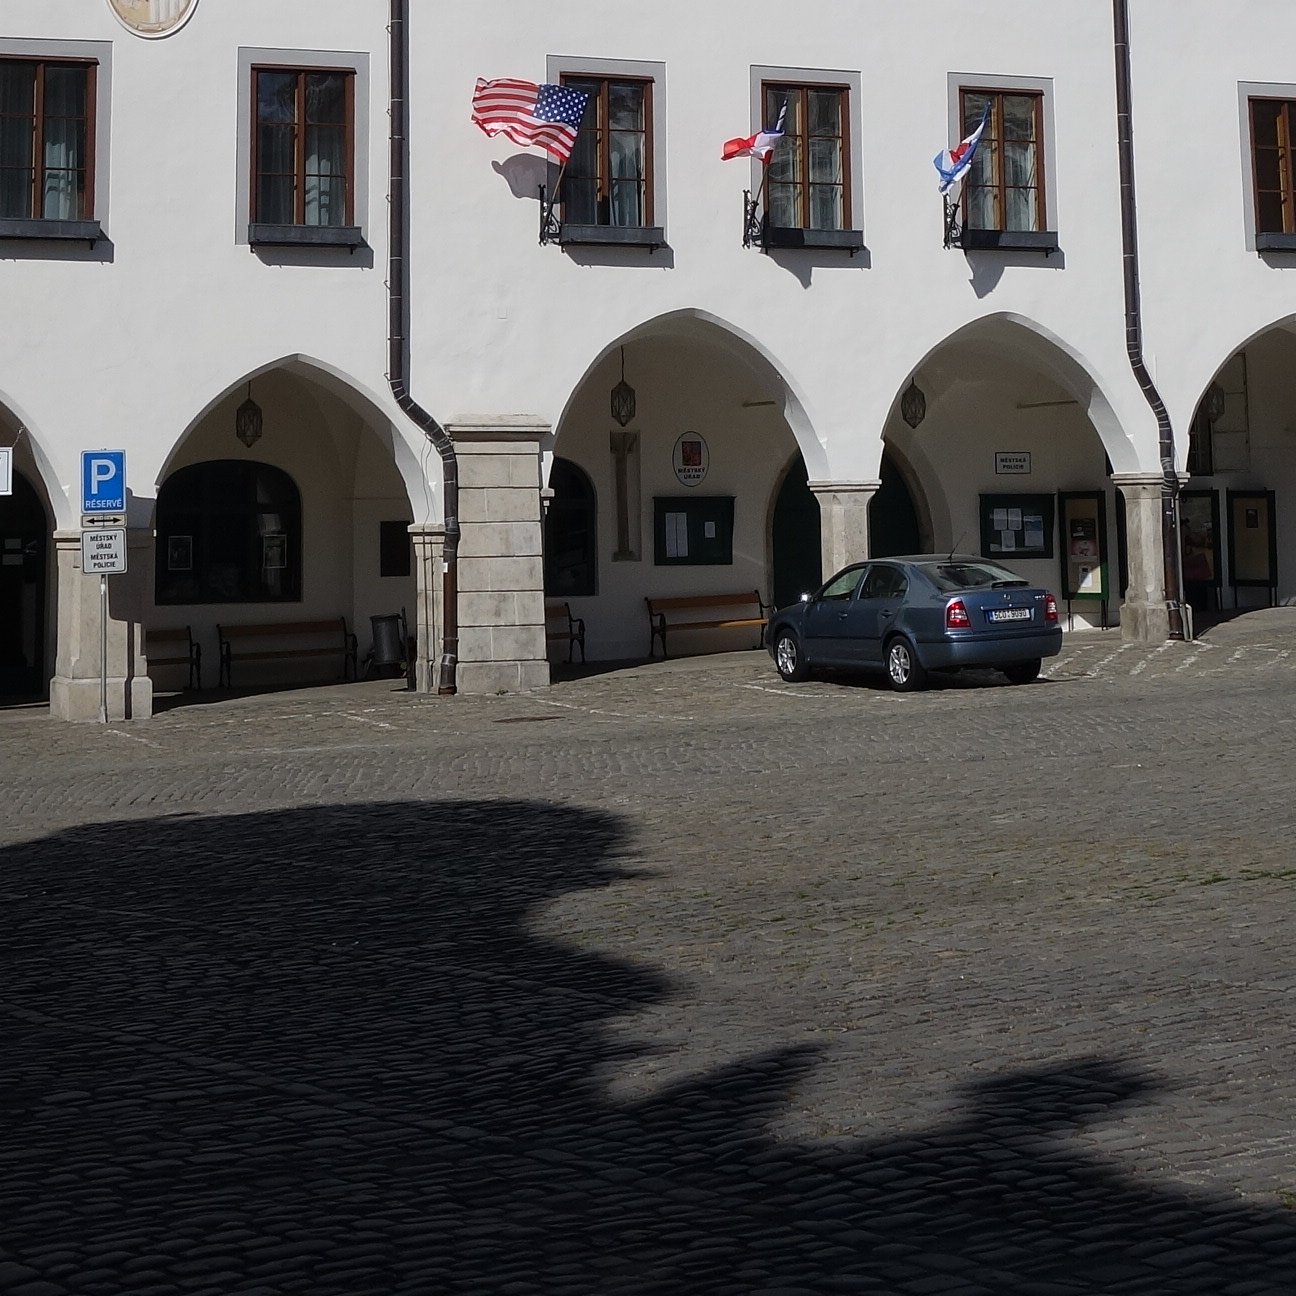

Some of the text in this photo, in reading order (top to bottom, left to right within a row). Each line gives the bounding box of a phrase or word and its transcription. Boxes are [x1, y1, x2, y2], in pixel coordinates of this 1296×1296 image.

[91, 459, 116, 495] P
[85, 499, 122, 509] RÉSERVÉ
[90, 534, 118, 542] MĚSTSKÝ
[90, 552, 118, 561] MĚSTSKÁ
[93, 561, 116, 569] POLICIE
